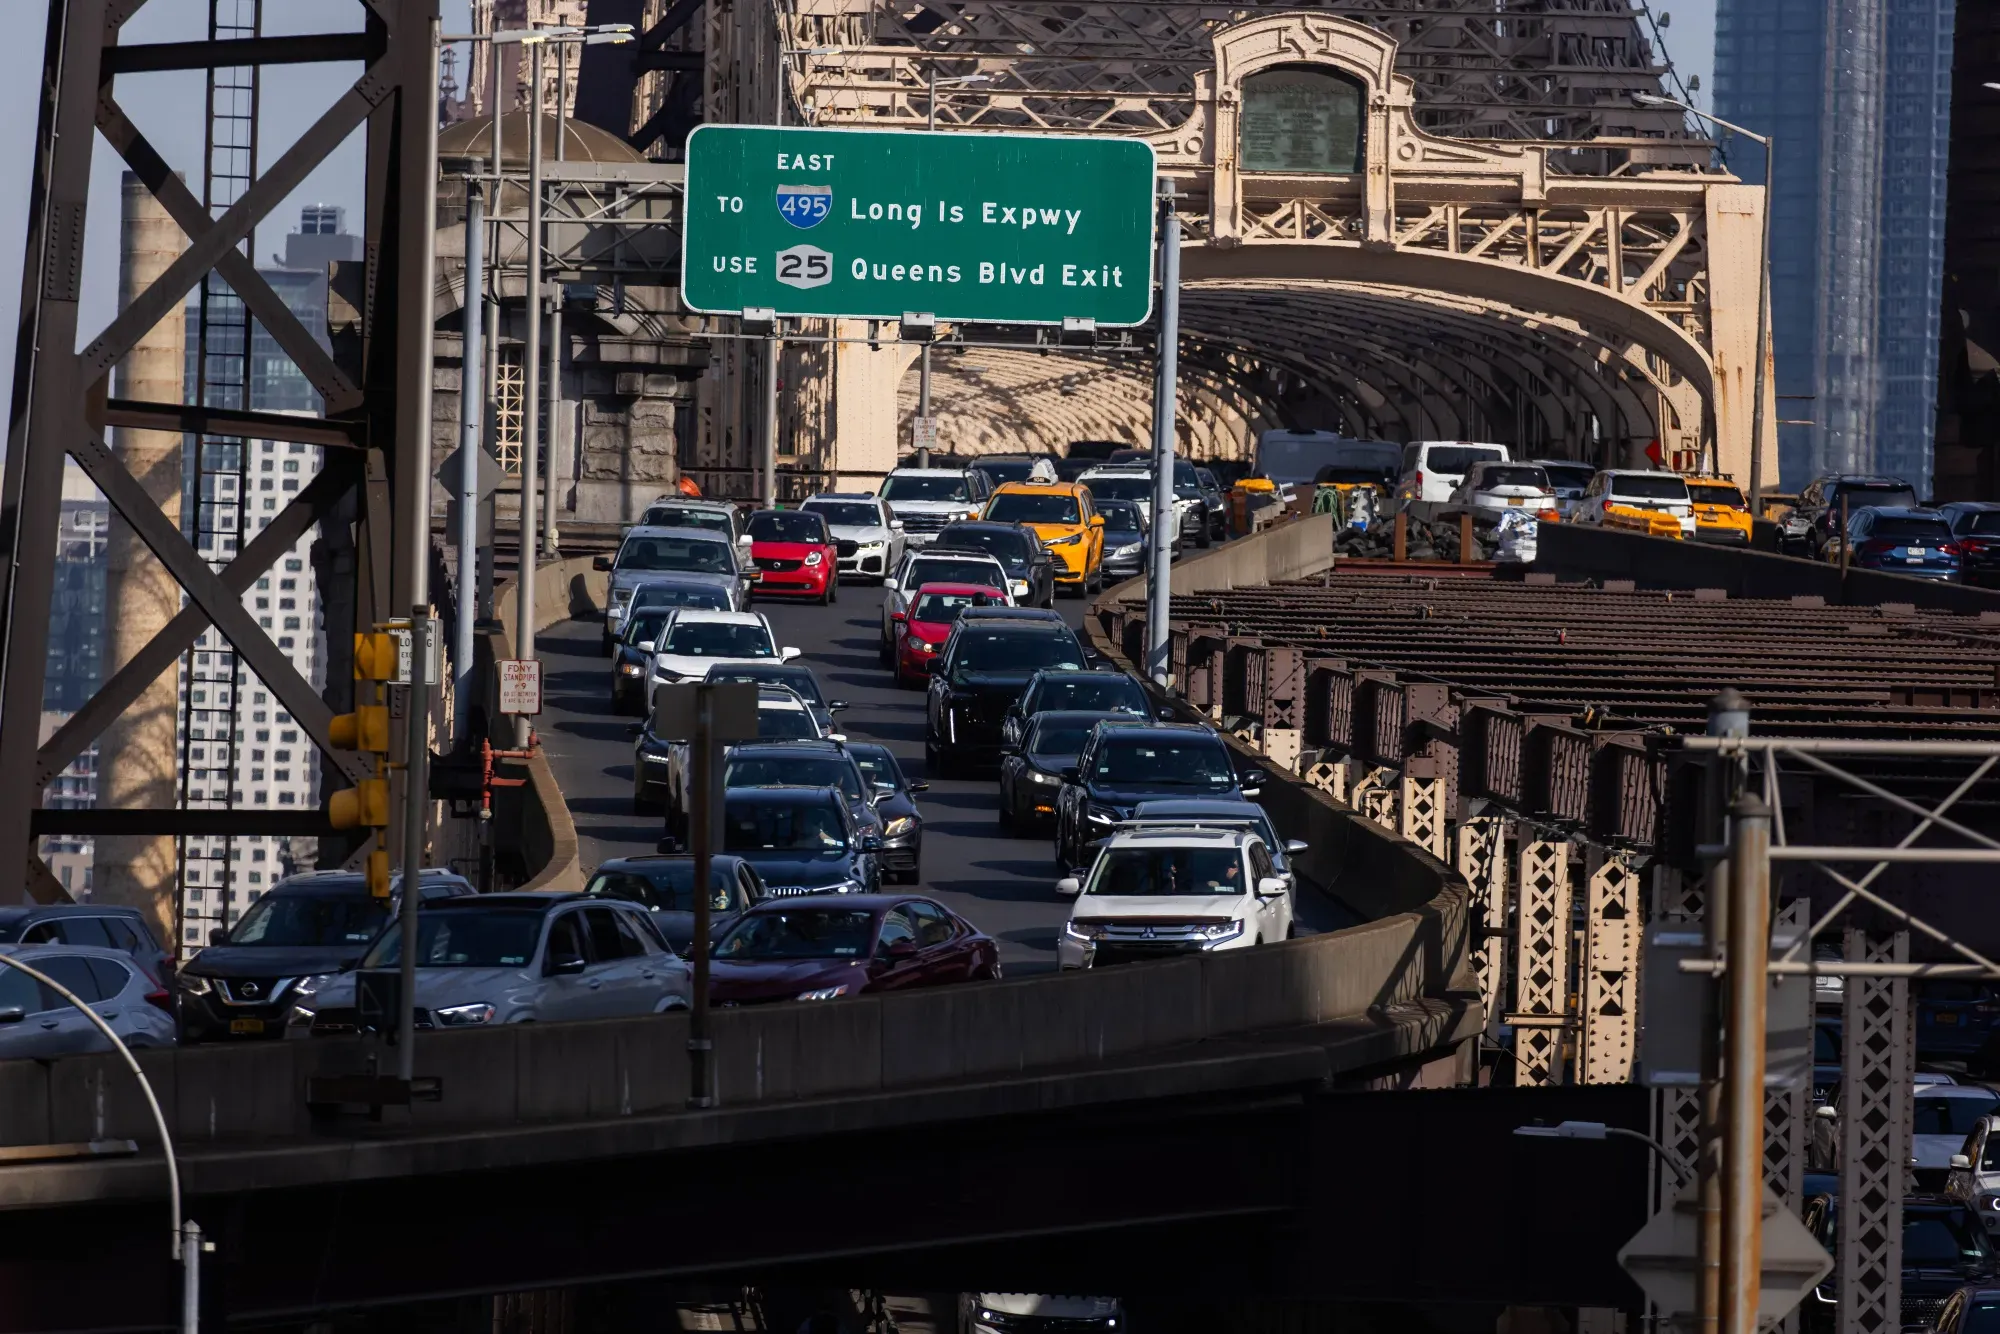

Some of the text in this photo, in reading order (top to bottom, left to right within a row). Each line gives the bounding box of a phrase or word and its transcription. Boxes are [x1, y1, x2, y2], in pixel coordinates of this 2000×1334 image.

[777, 153, 835, 171] EAST
[717, 196, 1082, 235] TO 495 Long Is Expwy
[713, 254, 1123, 288] USE 25 Queens Blvd Exit
[503, 673, 536, 681] STANDPIPE
[507, 664, 532, 672] FDNY
